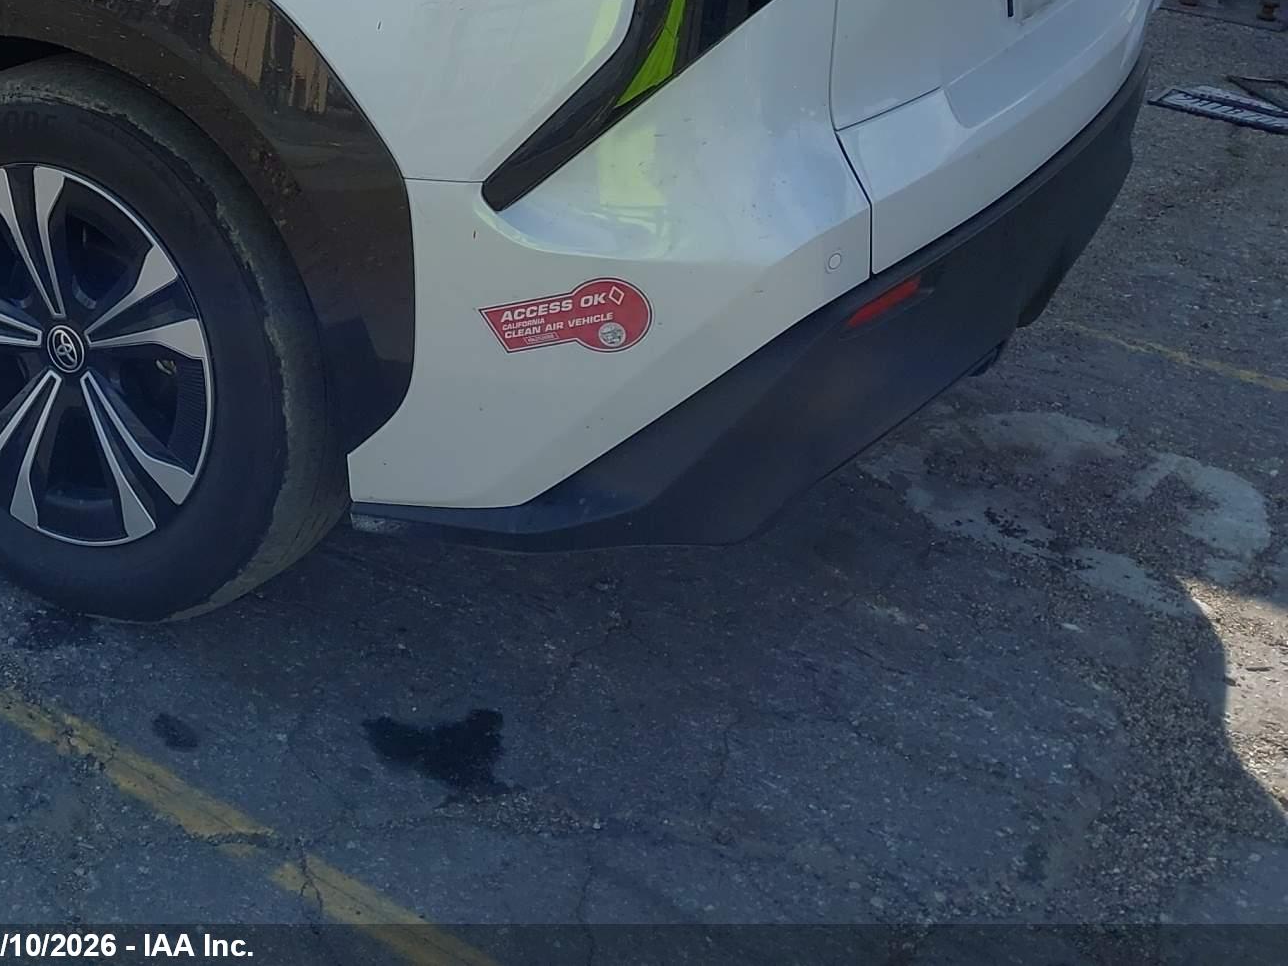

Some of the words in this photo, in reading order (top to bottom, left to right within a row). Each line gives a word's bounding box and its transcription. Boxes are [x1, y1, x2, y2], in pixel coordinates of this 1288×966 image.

[500, 299, 573, 323] ACCESS
[580, 292, 607, 308] OK
[502, 318, 545, 331] CALIFORNIA
[504, 326, 541, 339] CLEAN
[545, 321, 564, 333] AIR
[567, 312, 614, 327] VEHICLE
